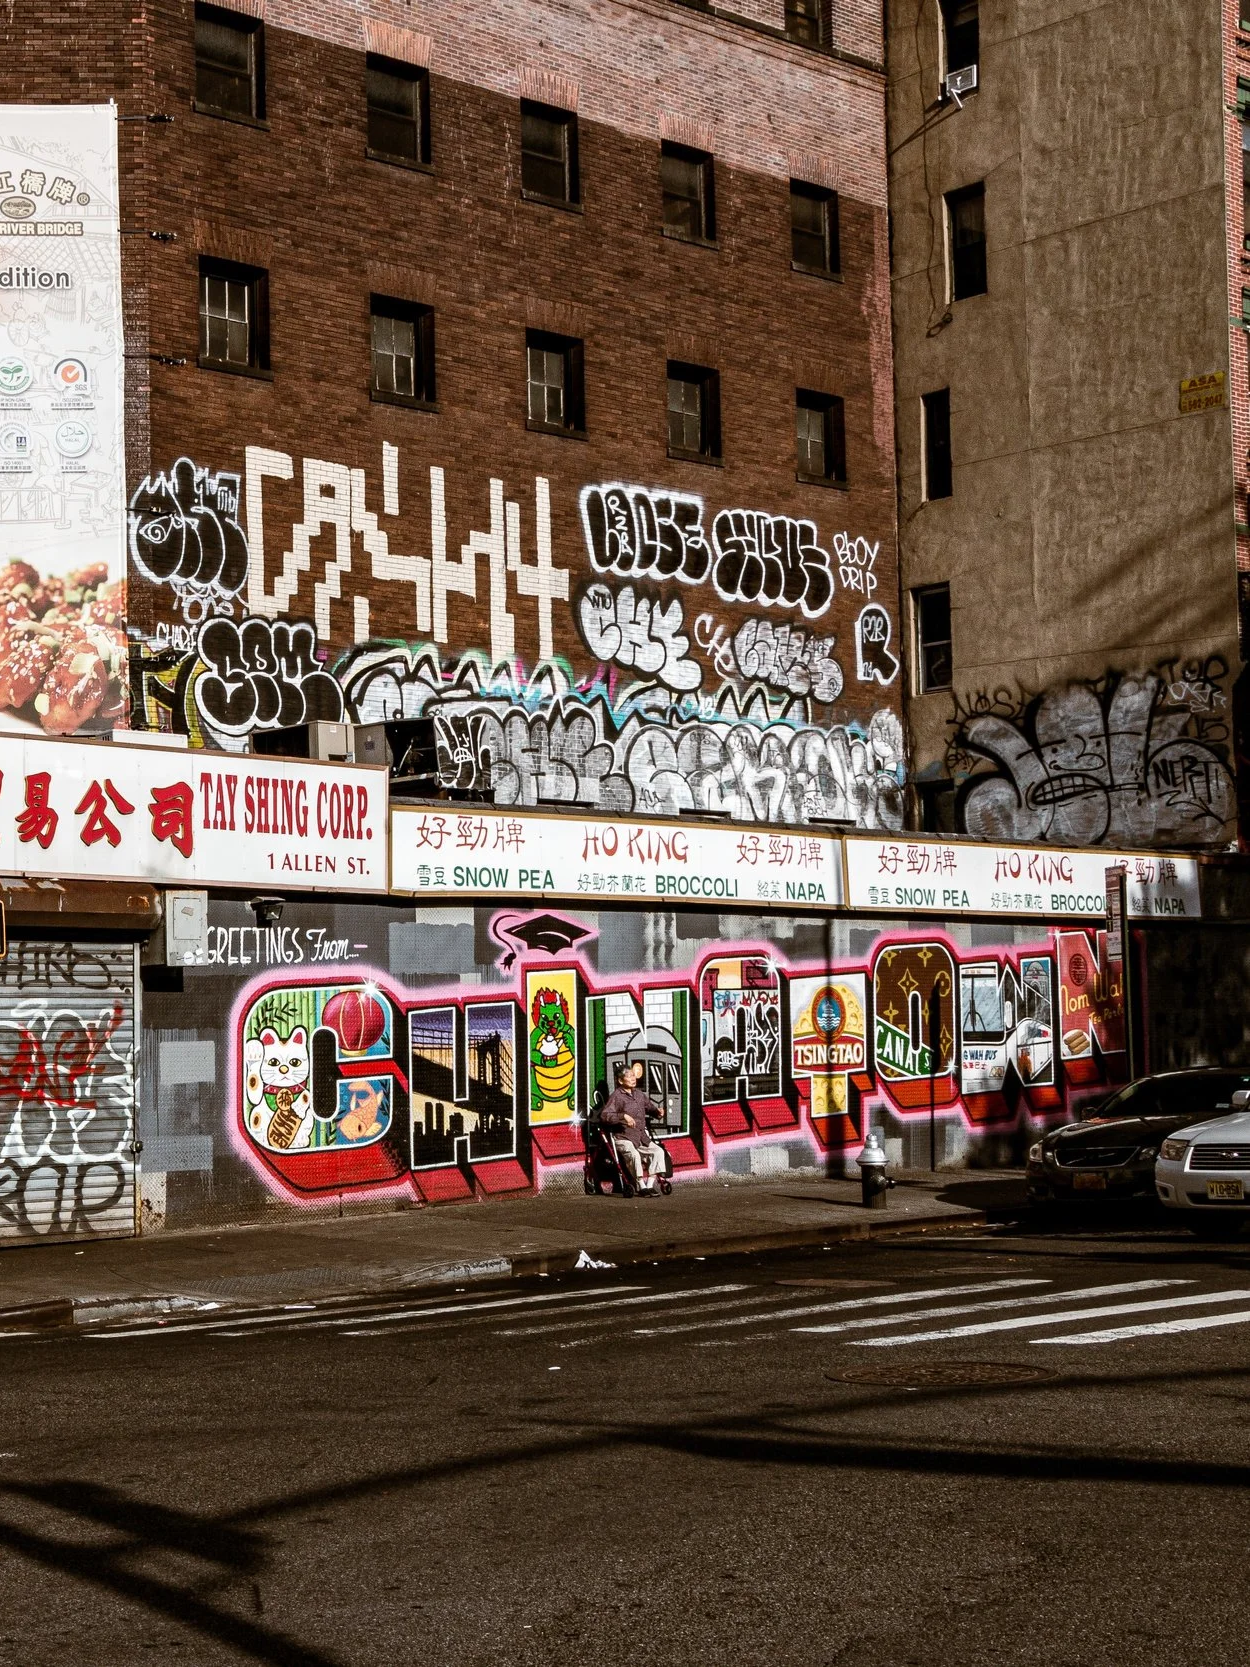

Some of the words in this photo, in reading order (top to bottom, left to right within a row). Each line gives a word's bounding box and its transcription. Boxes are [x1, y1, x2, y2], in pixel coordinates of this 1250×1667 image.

[37, 222, 83, 236] BRIDGE
[200, 772, 238, 831] TAY
[244, 775, 308, 837] SHING
[316, 782, 373, 840] CORP.
[416, 814, 525, 854] 好勁牌
[582, 825, 619, 862] HO
[628, 828, 689, 866] KING
[267, 853, 275, 870] 1
[281, 853, 336, 874] ALLEN
[347, 857, 371, 875] ST.
[736, 834, 824, 871] 好勁牌
[877, 844, 958, 877] 好勁牌
[417, 864, 447, 886] 雪豆
[453, 865, 509, 888] SNOW
[518, 869, 555, 890] PEA
[995, 852, 1021, 882] HO
[1027, 854, 1075, 886] KING
[655, 875, 738, 898] BROCCOLI
[786, 881, 826, 902] NAPA
[867, 885, 892, 905] 雪豆
[895, 887, 936, 906] SNOW
[943, 889, 970, 907] PEA
[1051, 894, 1108, 913] BROCCOL
[1154, 897, 1186, 915] NAPA
[207, 926, 304, 964] GREETINGS
[795, 1043, 864, 1066] TSINGTAO
[875, 1024, 922, 1077] CANAL
[969, 1049, 983, 1061] WAH
[984, 1049, 998, 1060] BUS
